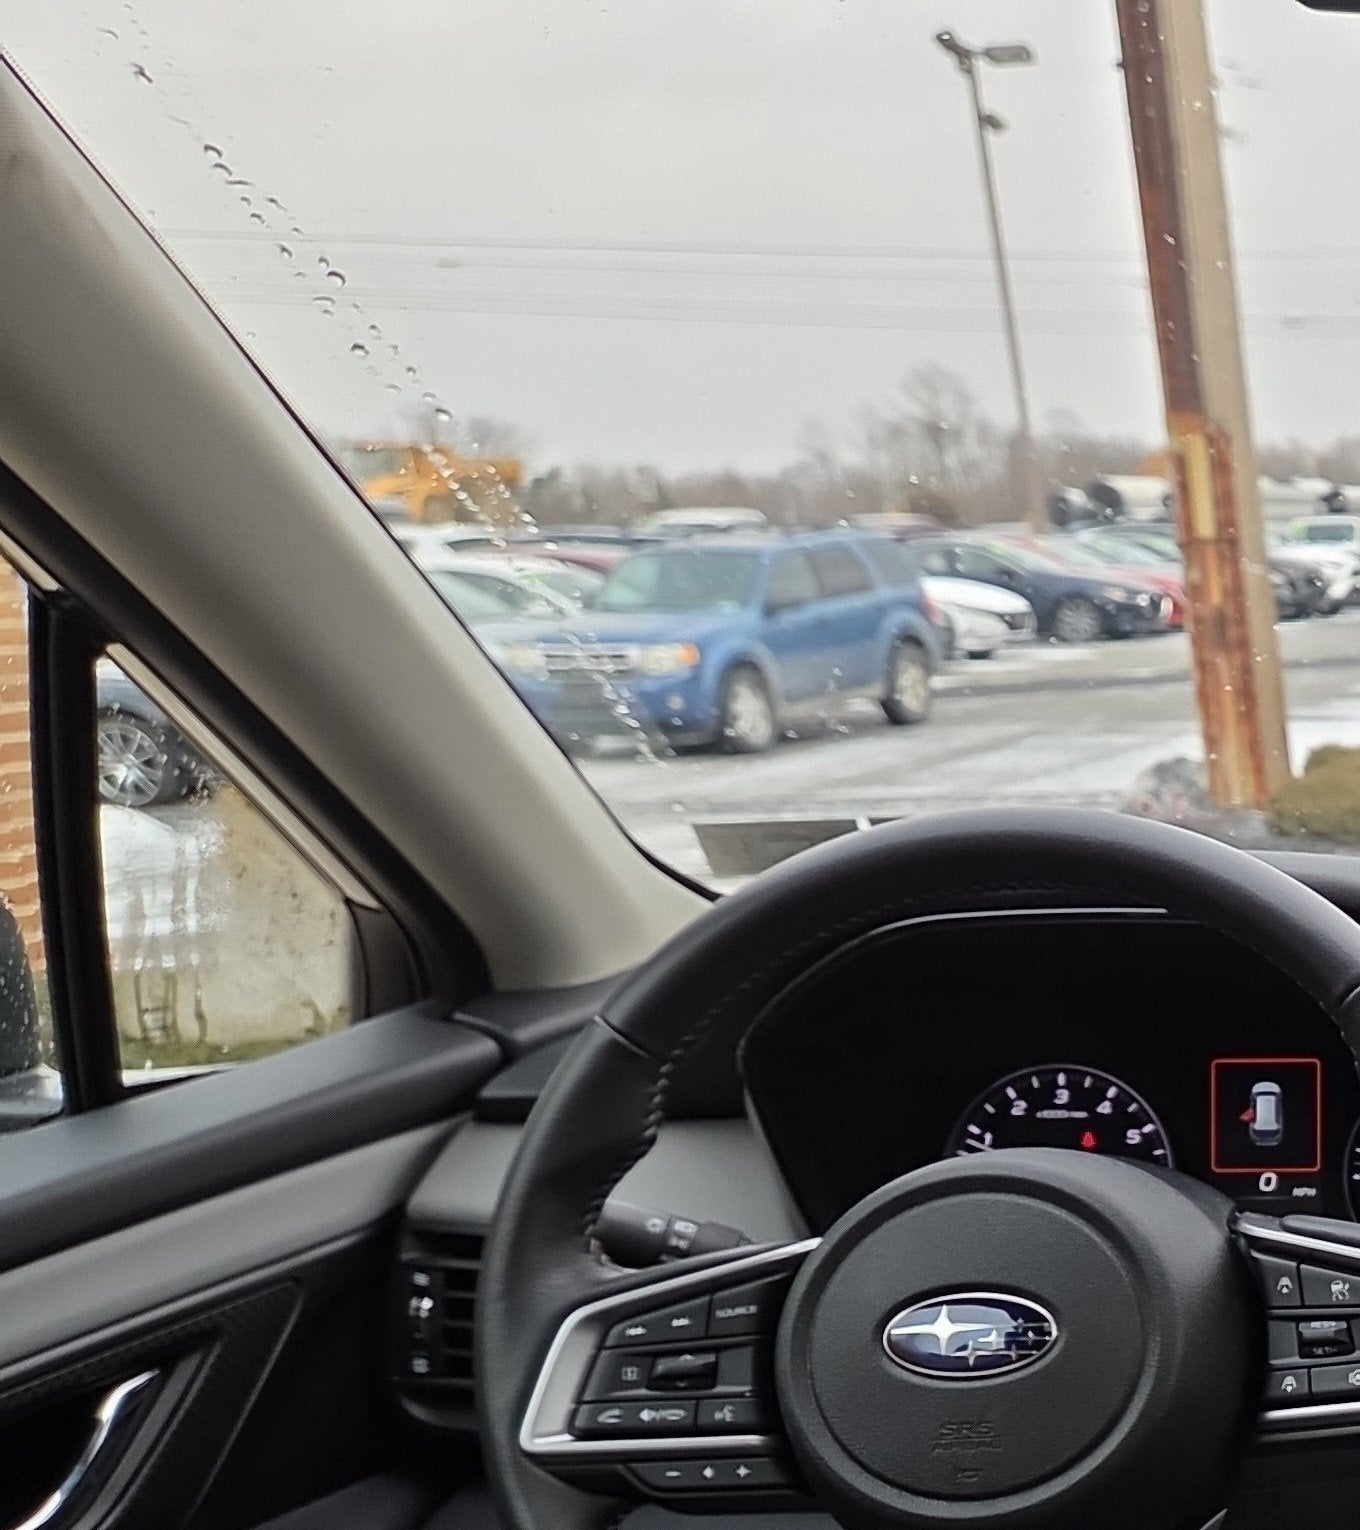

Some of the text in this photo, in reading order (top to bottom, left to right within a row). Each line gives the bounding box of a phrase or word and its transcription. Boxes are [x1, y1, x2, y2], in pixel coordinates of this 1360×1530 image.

[1053, 1088, 1070, 1104] 3
[1010, 1100, 1028, 1116] 2
[1096, 1100, 1112, 1114] 4
[1126, 1128, 1142, 1144] 5
[1258, 1172, 1278, 1192] 0
